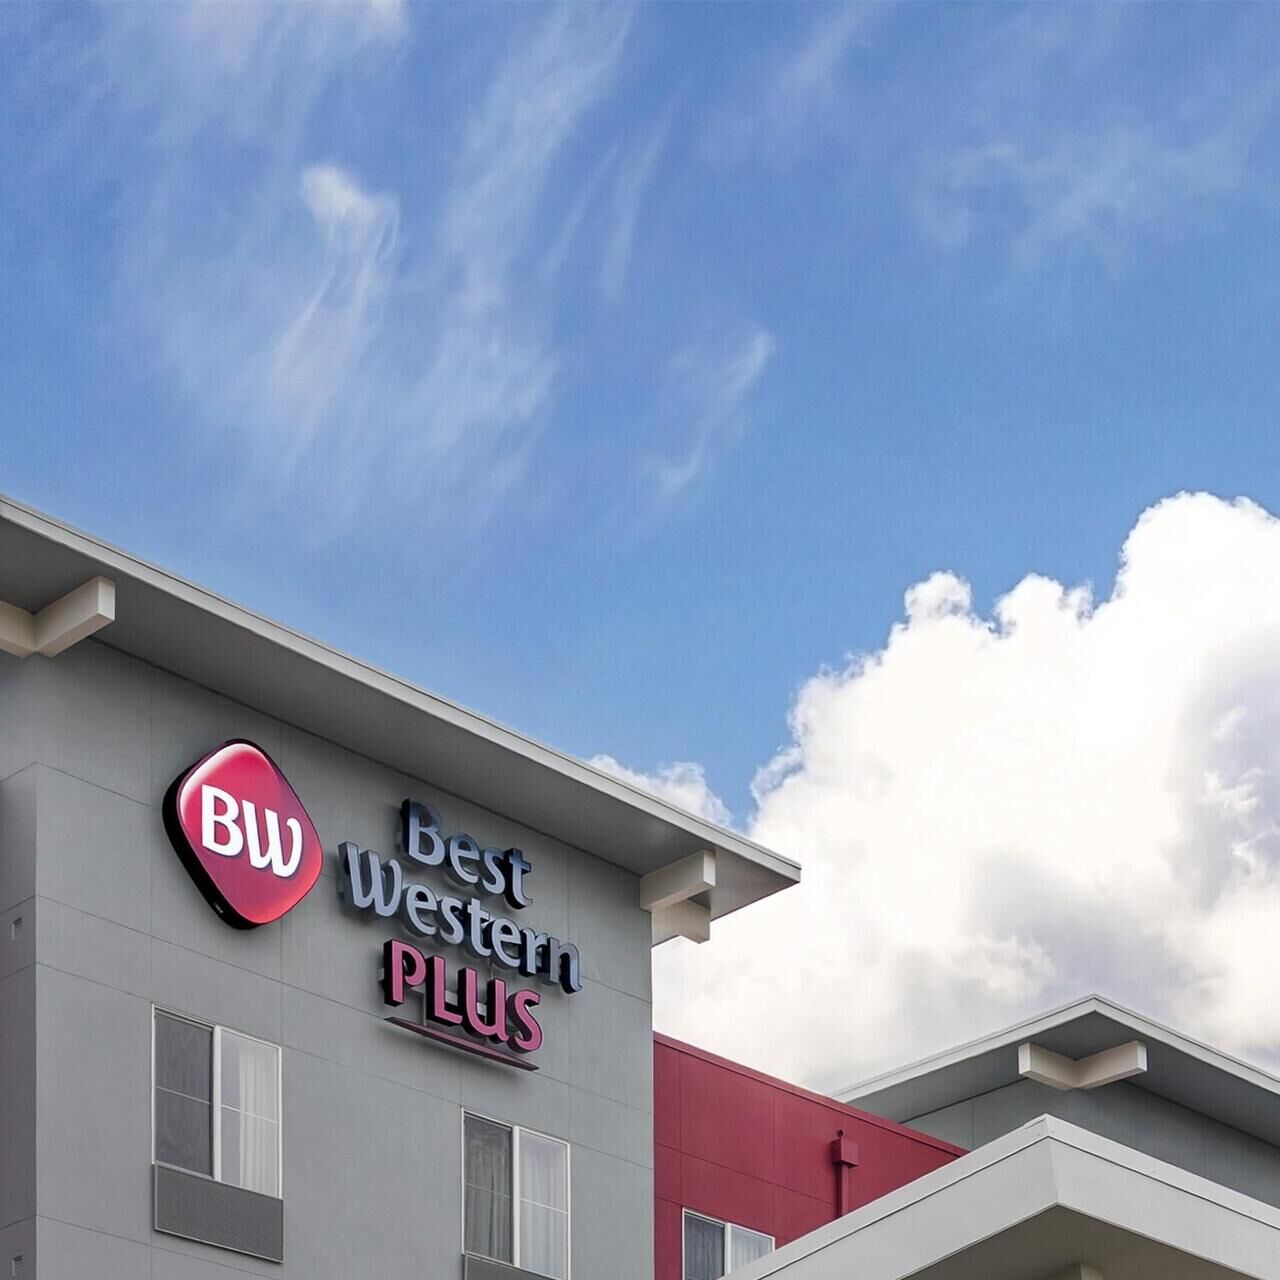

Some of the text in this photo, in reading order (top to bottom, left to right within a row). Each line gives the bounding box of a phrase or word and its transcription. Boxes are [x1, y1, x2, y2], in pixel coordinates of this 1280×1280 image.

[201, 784, 303, 878] BW
[401, 798, 533, 909] Best
[337, 841, 584, 995] Western
[383, 939, 544, 1053] PLUS
